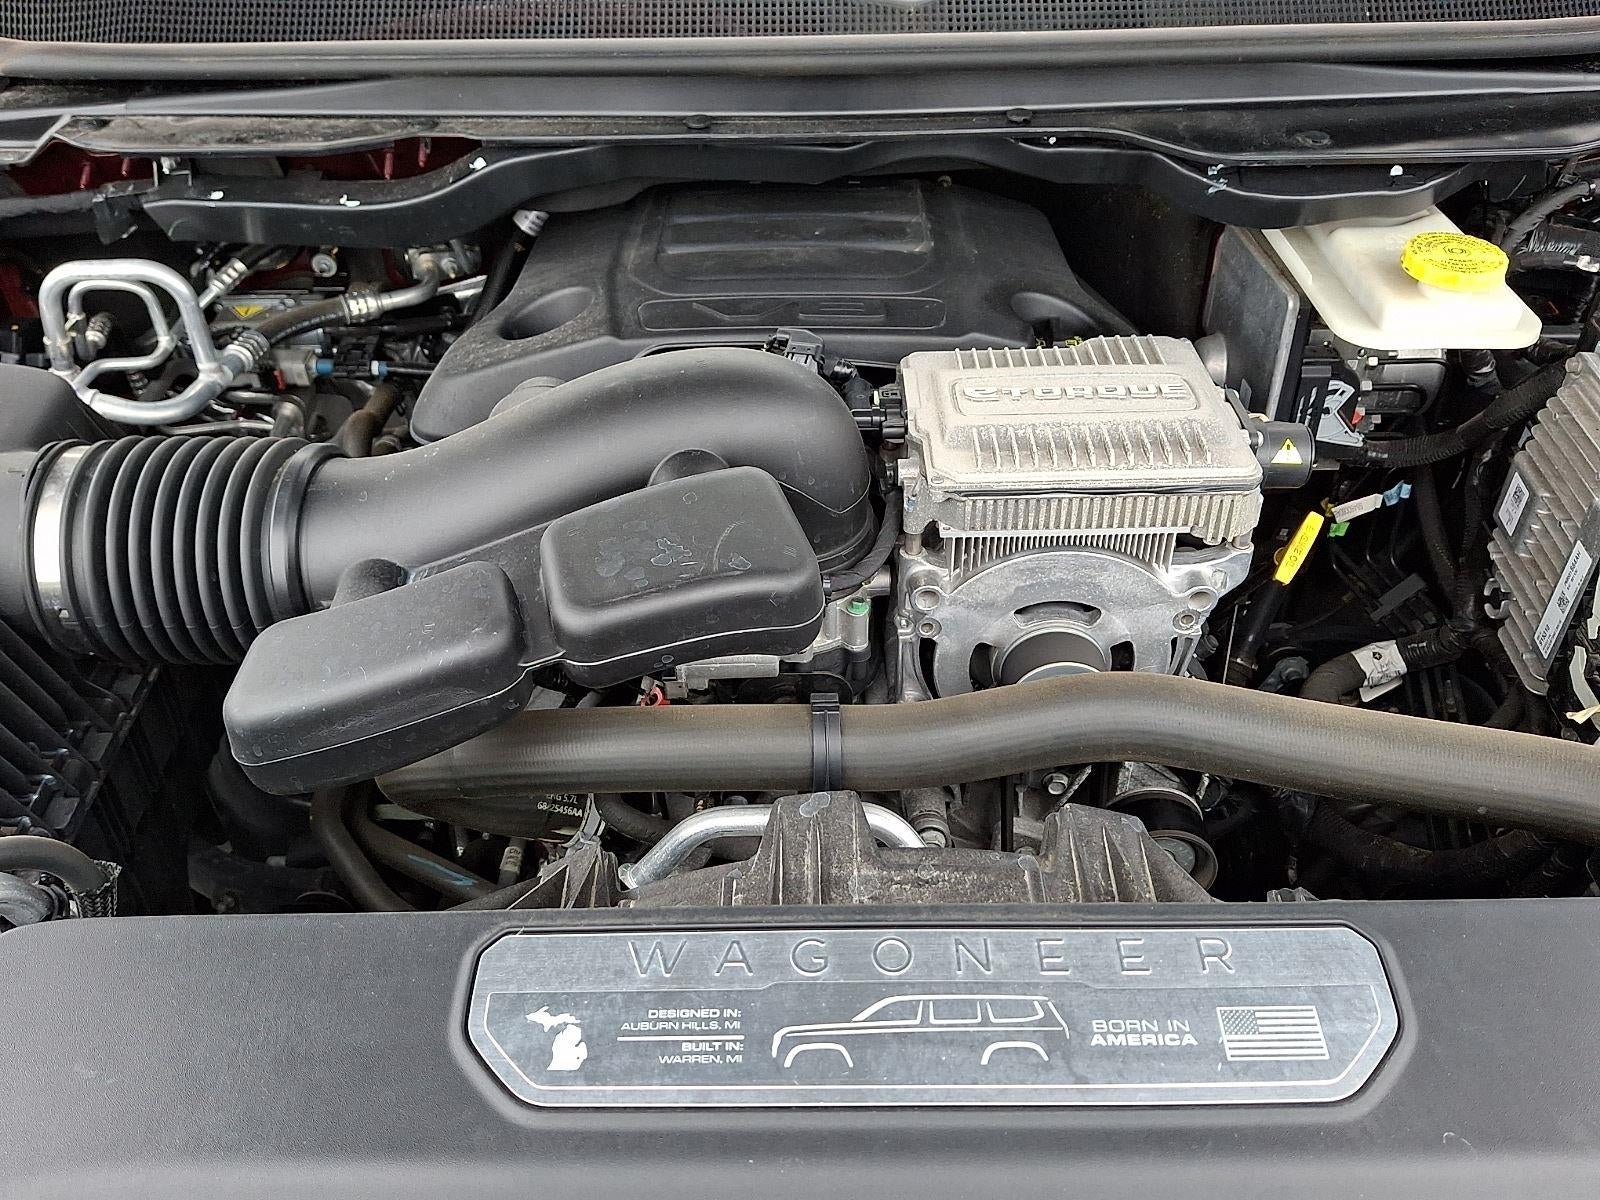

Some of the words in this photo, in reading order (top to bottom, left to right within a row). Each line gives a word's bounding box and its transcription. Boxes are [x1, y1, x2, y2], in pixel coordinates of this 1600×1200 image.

[627, 936, 1236, 978] WAGONEER
[648, 1008, 721, 1019] DESIGNED
[723, 1008, 742, 1018] IN:
[620, 1021, 679, 1031] AUBURN
[724, 1020, 740, 1030] MI
[1092, 1019, 1159, 1032] BORN
[1167, 1019, 1191, 1032] IN
[1090, 1033, 1199, 1046] AMERICA
[681, 1041, 723, 1052] BUILT
[725, 1041, 744, 1051] IN:
[725, 1054, 743, 1063] MI
